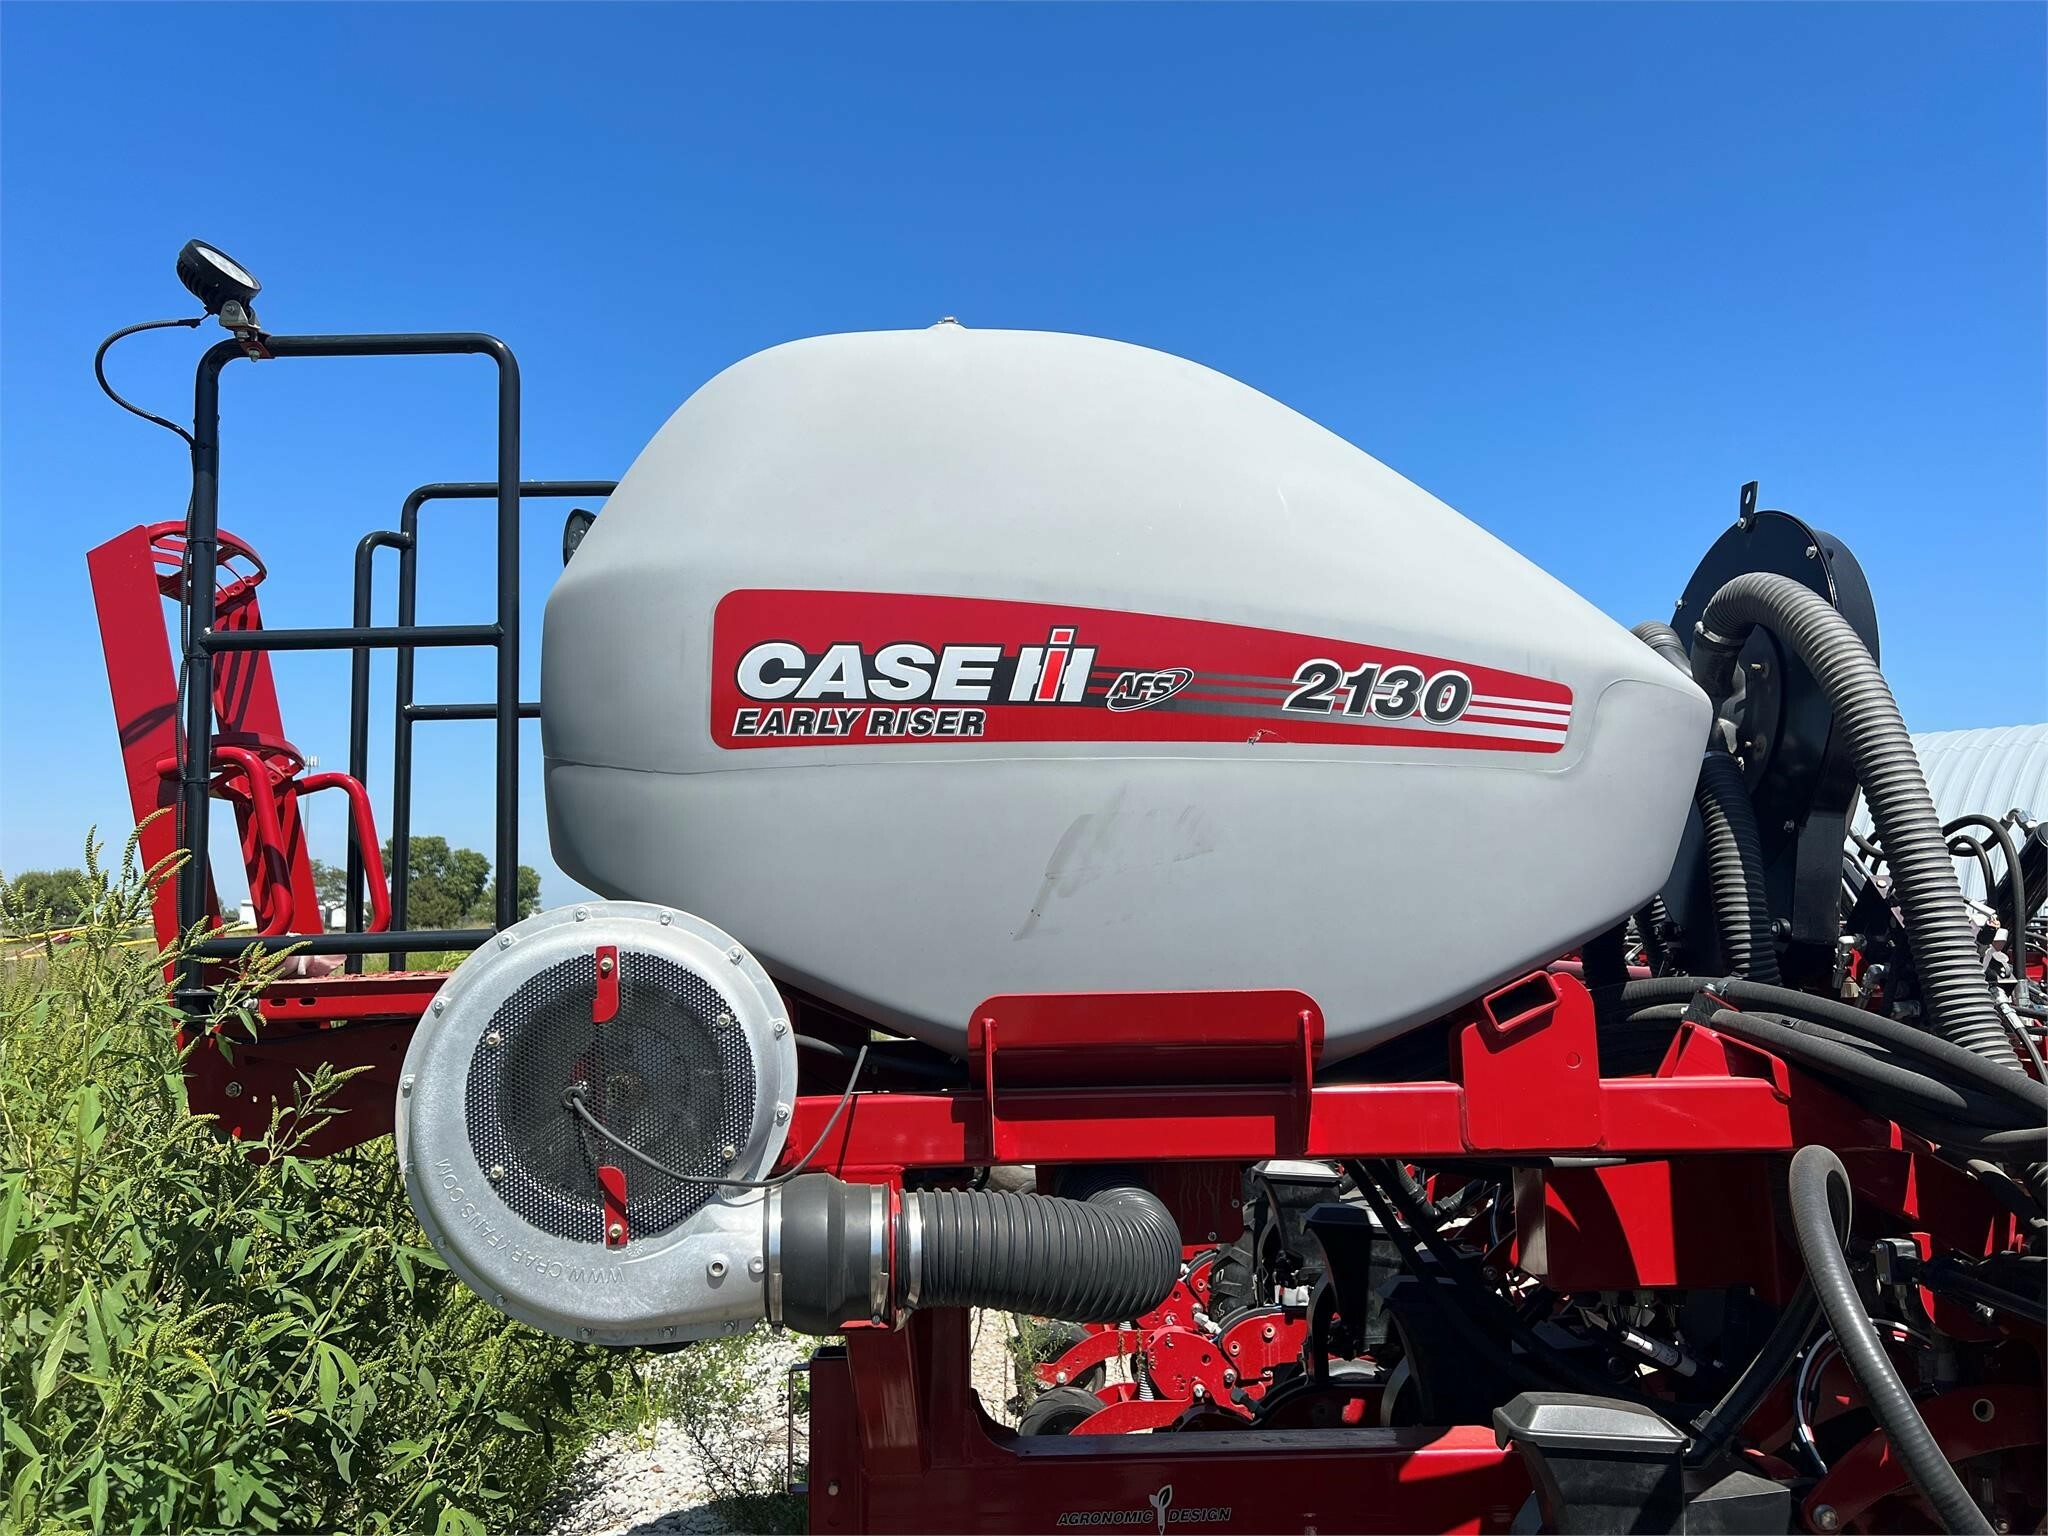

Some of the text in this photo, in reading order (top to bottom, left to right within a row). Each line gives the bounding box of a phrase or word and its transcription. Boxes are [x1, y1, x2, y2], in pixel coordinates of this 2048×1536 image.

[737, 641, 1003, 702] CASE
[1108, 670, 1177, 703] AFS
[1282, 658, 1473, 726] 2130
[732, 707, 987, 737] EARLY RISER
[1056, 1507, 1232, 1526] AGRONOMIC DESIGN
